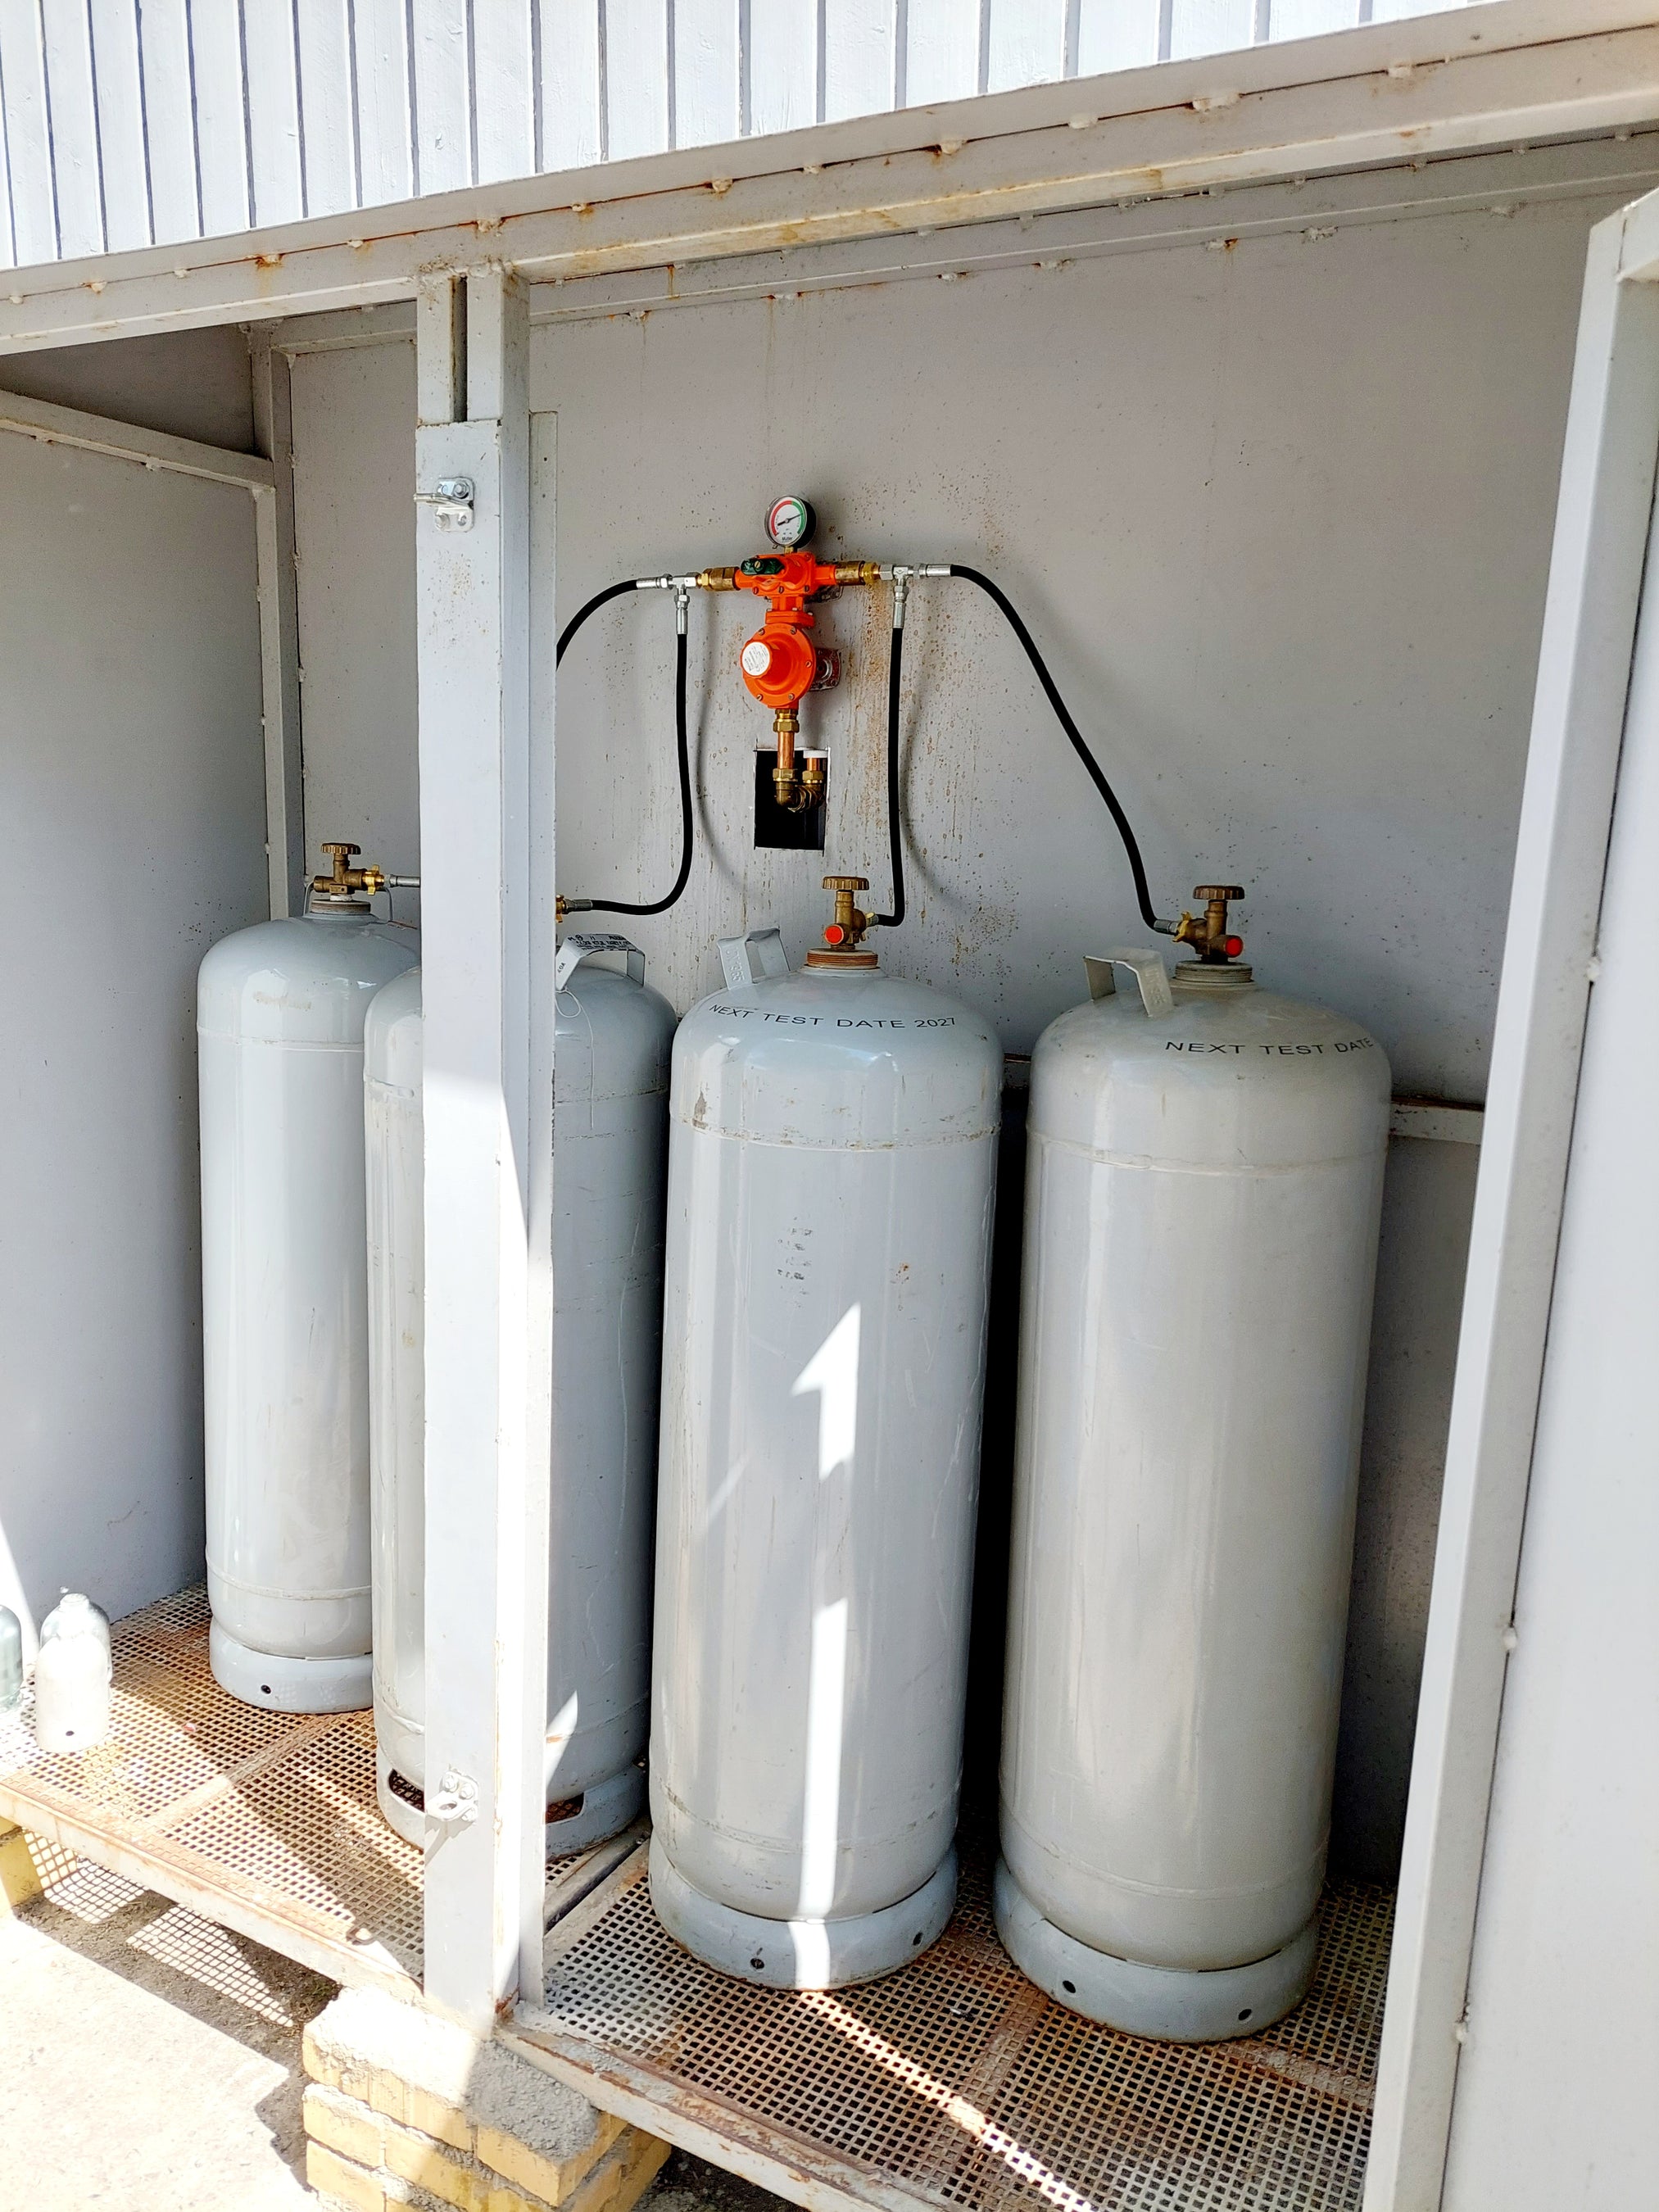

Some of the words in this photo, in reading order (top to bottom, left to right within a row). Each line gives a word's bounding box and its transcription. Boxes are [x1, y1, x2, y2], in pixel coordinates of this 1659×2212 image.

[709, 1004, 755, 1018] NEXT
[763, 1013, 824, 1026] TEST
[836, 1019, 905, 1028] DATE
[914, 1018, 955, 1028] 2027
[1165, 1041, 1245, 1054] NEXT
[1259, 1045, 1323, 1055] TEST
[1334, 1037, 1374, 1053] DATE
